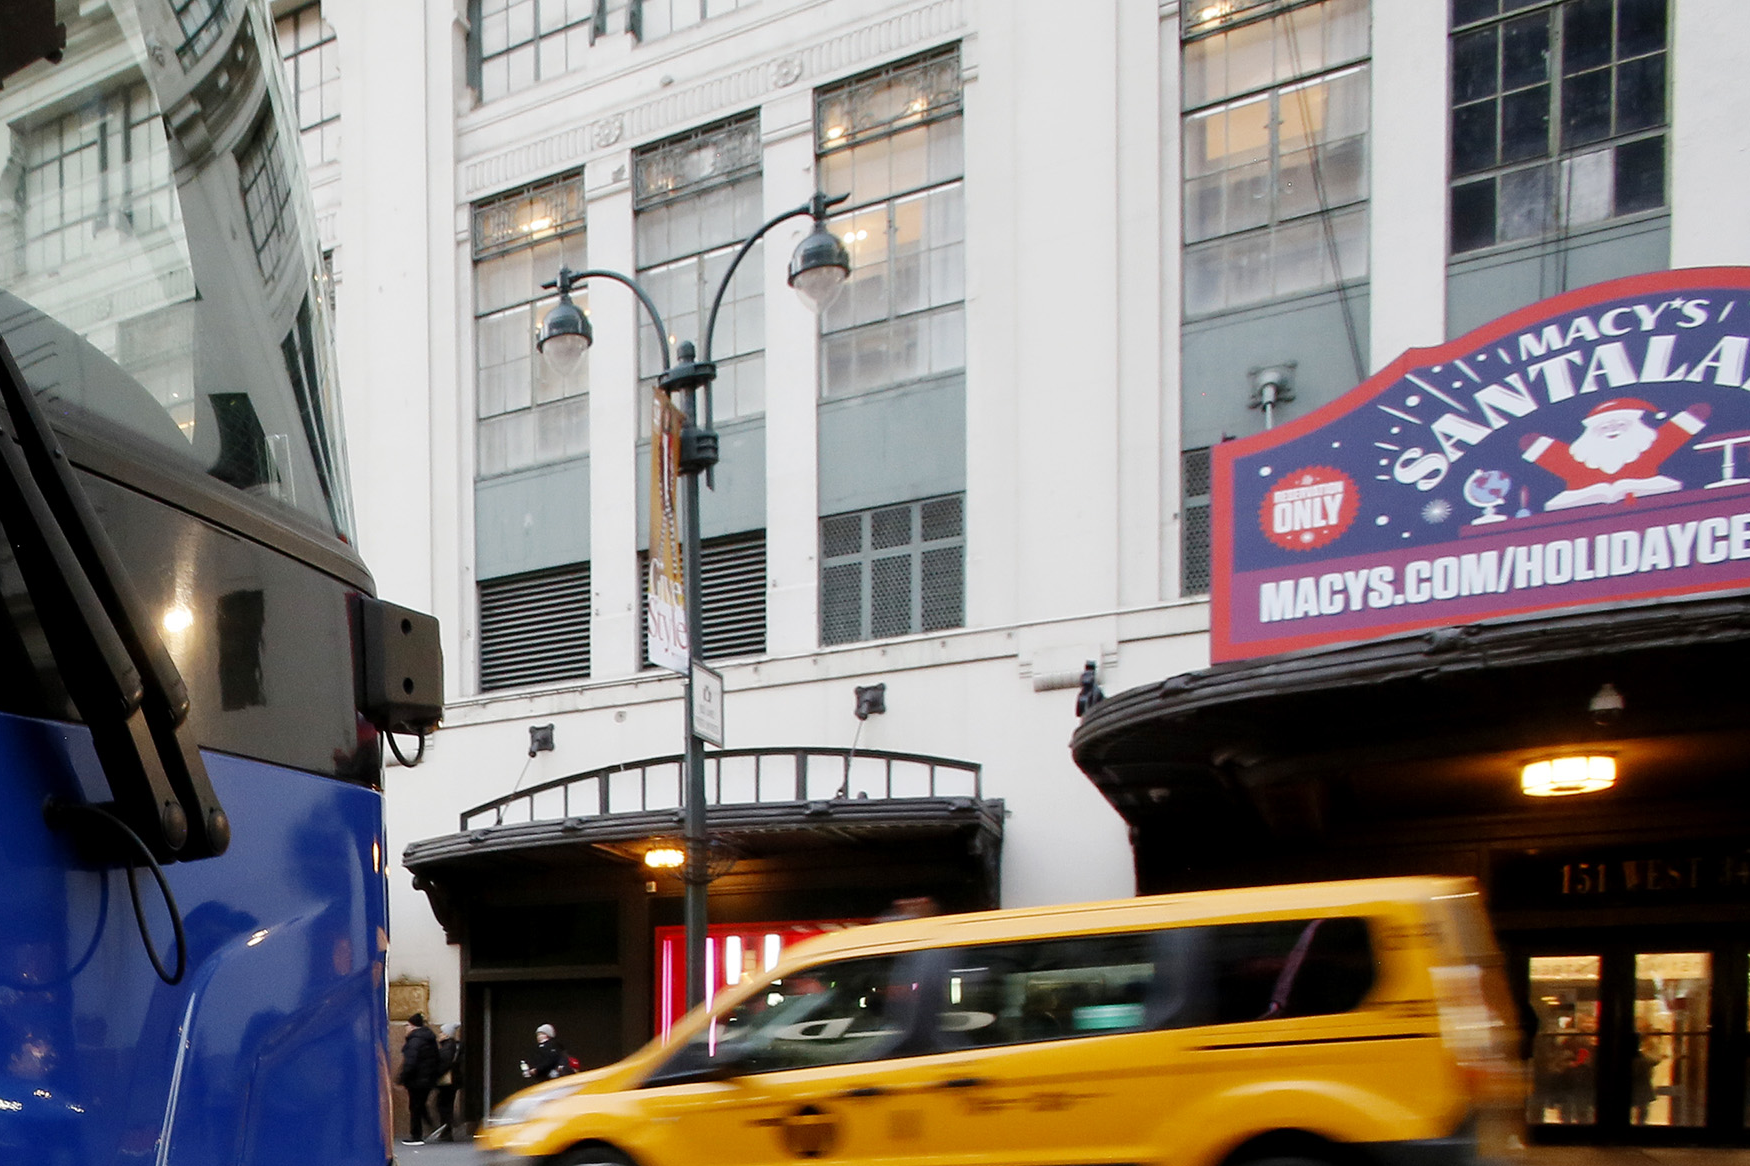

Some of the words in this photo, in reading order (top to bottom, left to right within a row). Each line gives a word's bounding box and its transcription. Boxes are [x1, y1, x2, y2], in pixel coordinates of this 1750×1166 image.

[1392, 333, 1750, 492] SANTALA
[1272, 492, 1344, 535] ONLY
[1259, 513, 1750, 624] MACYS.COM/HOLIDAYCE
[1559, 862, 1608, 895] 151
[1621, 857, 1704, 891] WEST
